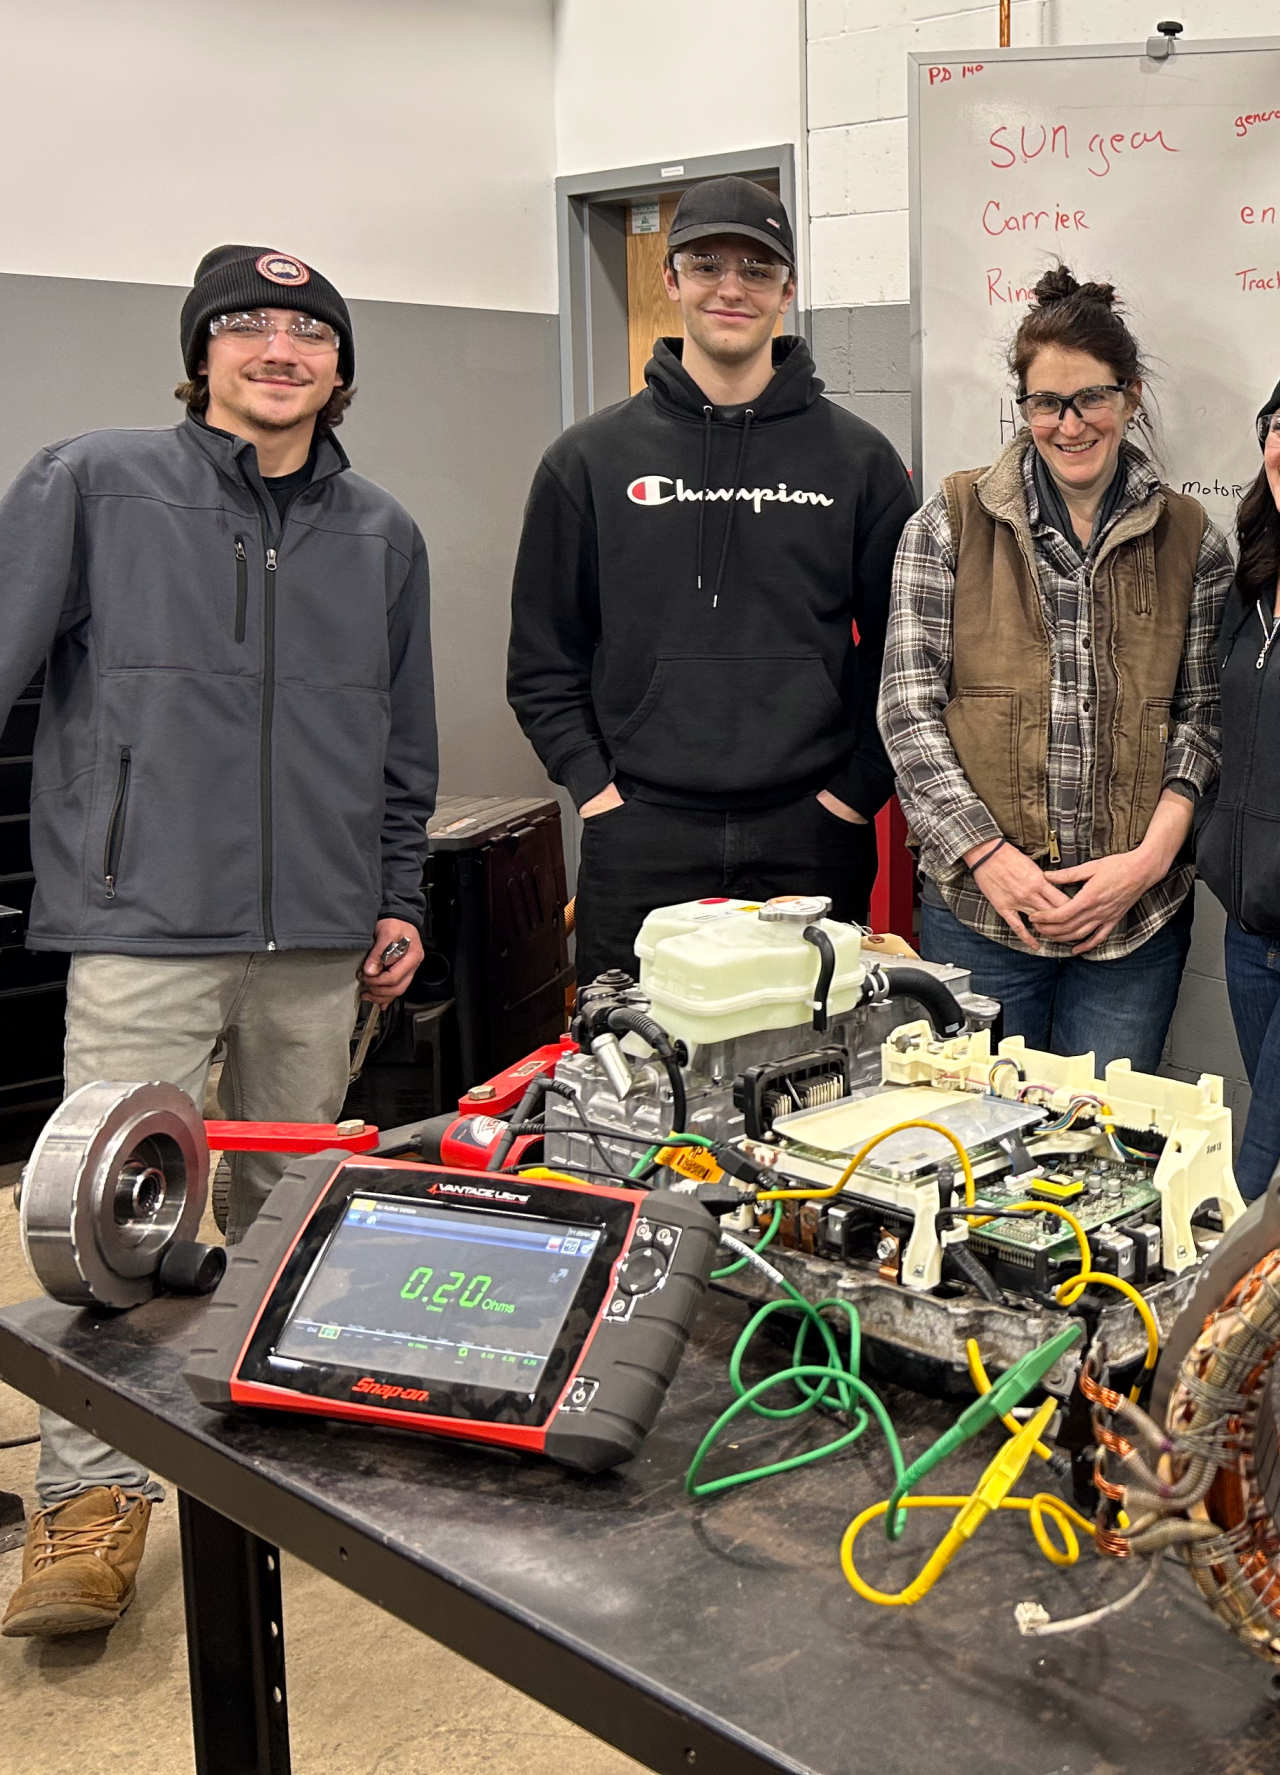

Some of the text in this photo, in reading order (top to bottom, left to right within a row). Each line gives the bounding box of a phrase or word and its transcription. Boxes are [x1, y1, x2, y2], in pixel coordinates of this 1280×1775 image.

[627, 475, 834, 514] Champion
[438, 1183, 496, 1199] VANTAGE
[400, 1267, 515, 1314] 0.20 Ohms
[352, 1377, 429, 1401] Snap-on
